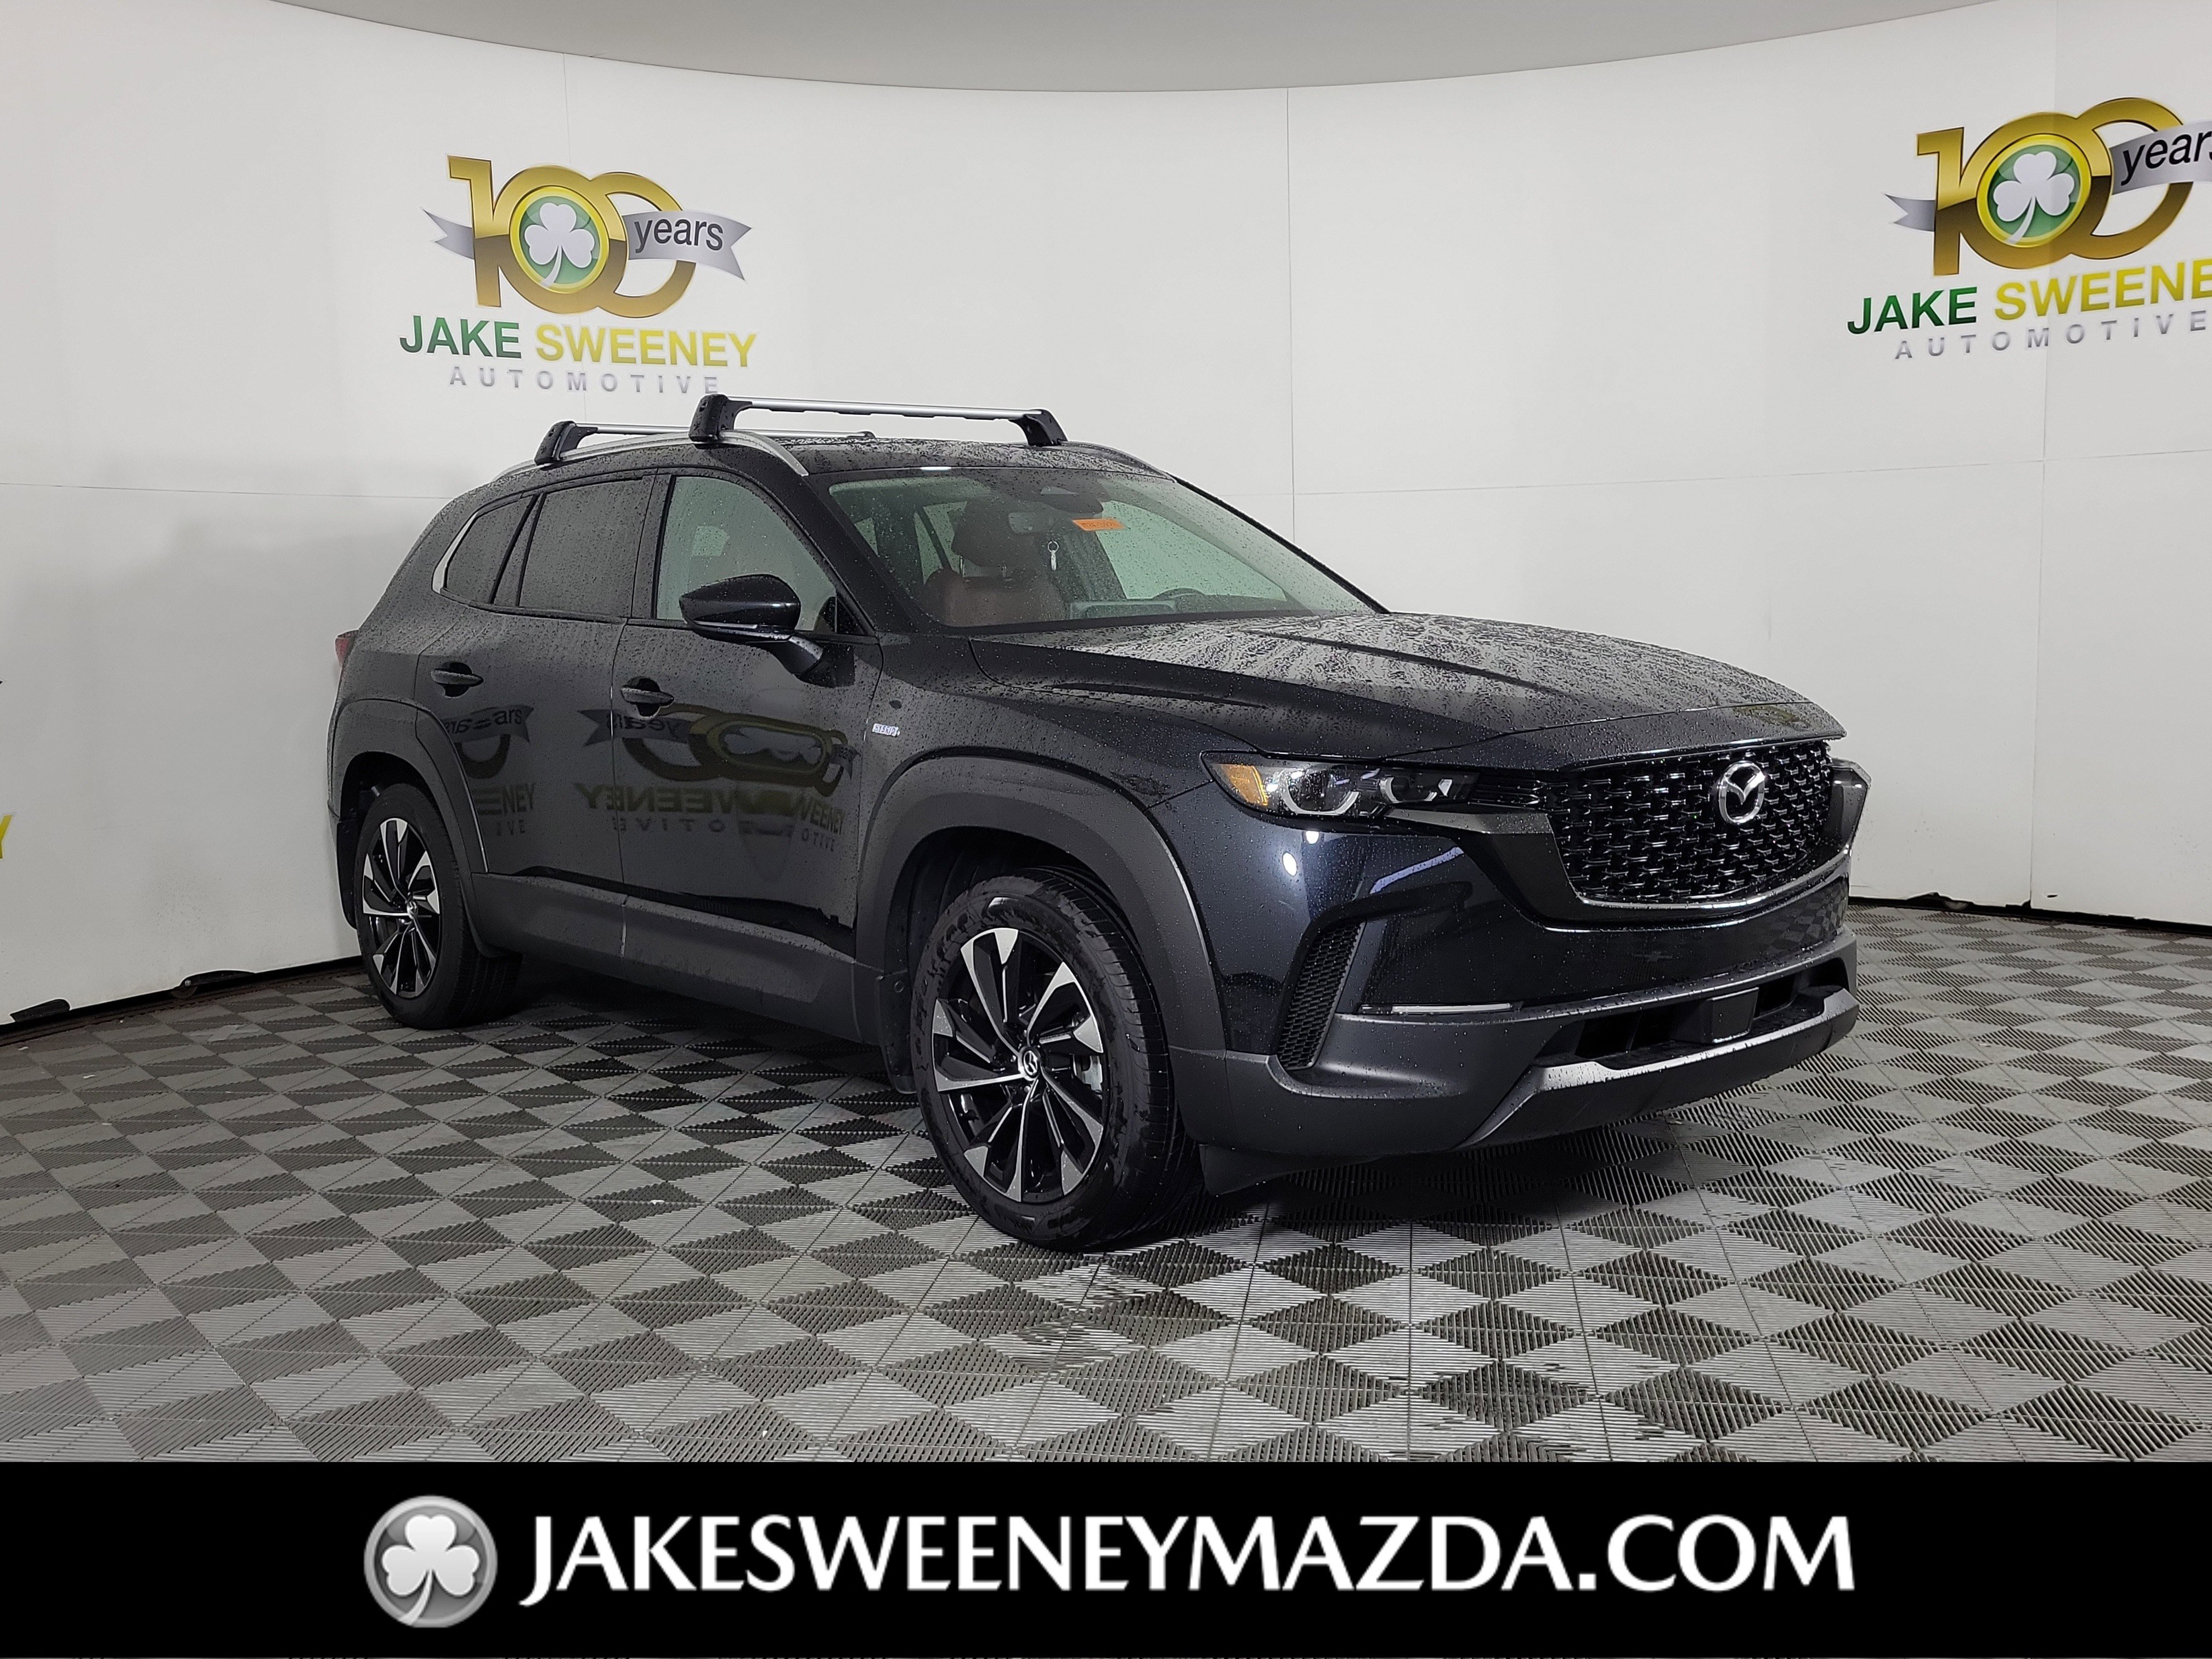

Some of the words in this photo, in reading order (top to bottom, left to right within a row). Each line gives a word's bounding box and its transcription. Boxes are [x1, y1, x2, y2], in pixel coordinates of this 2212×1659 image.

[2121, 131, 2212, 186] year
[635, 218, 723, 253] years
[1848, 287, 1977, 333] JAKE
[399, 315, 522, 358] JAKE
[536, 324, 756, 367] SWEENEY
[1895, 310, 2206, 359] AUTOMOTIVE
[449, 366, 718, 394] AUTOMOTIVE
